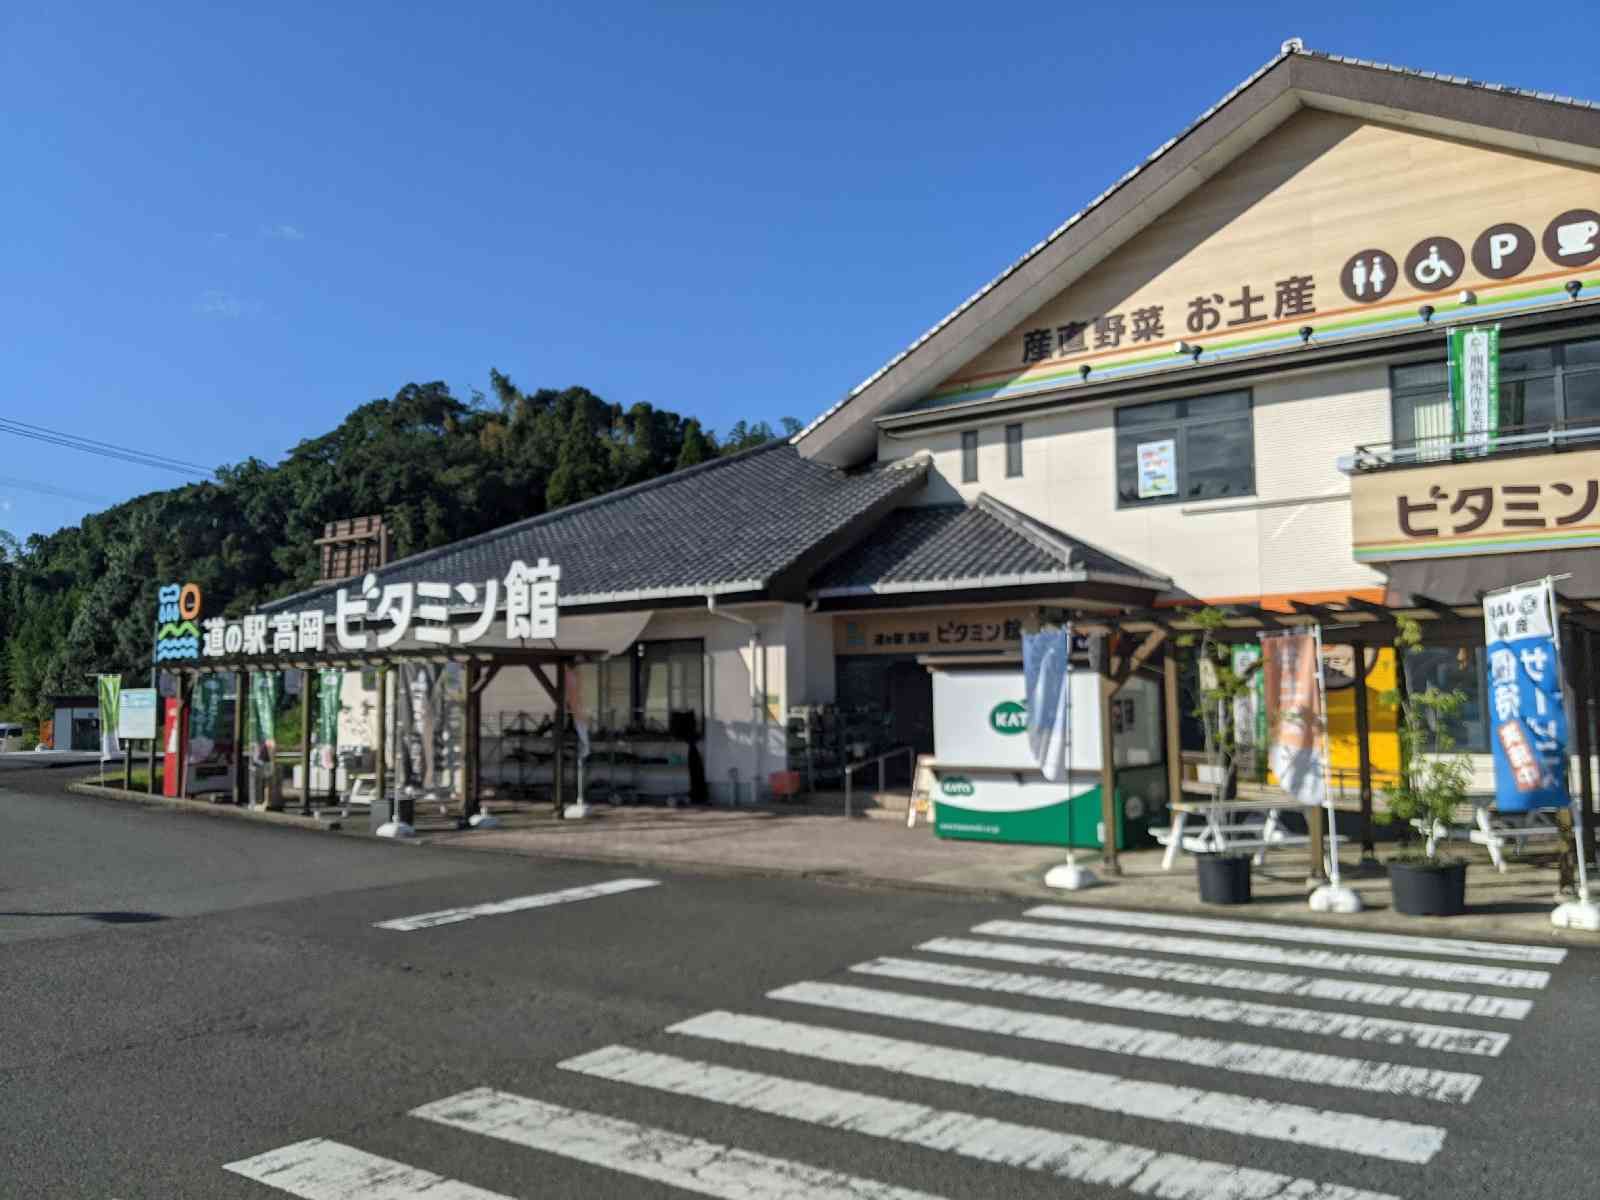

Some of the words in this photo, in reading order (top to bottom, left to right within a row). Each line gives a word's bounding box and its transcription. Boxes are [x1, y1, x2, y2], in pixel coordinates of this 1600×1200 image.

[1489, 232, 1518, 270] P
[1022, 305, 1164, 364] 産直野菜
[1186, 275, 1316, 332] お土産
[1397, 480, 1599, 537] ビタミン
[203, 614, 268, 657] 道の駅
[272, 608, 326, 655] 高岡
[336, 557, 561, 650] ビタミン館
